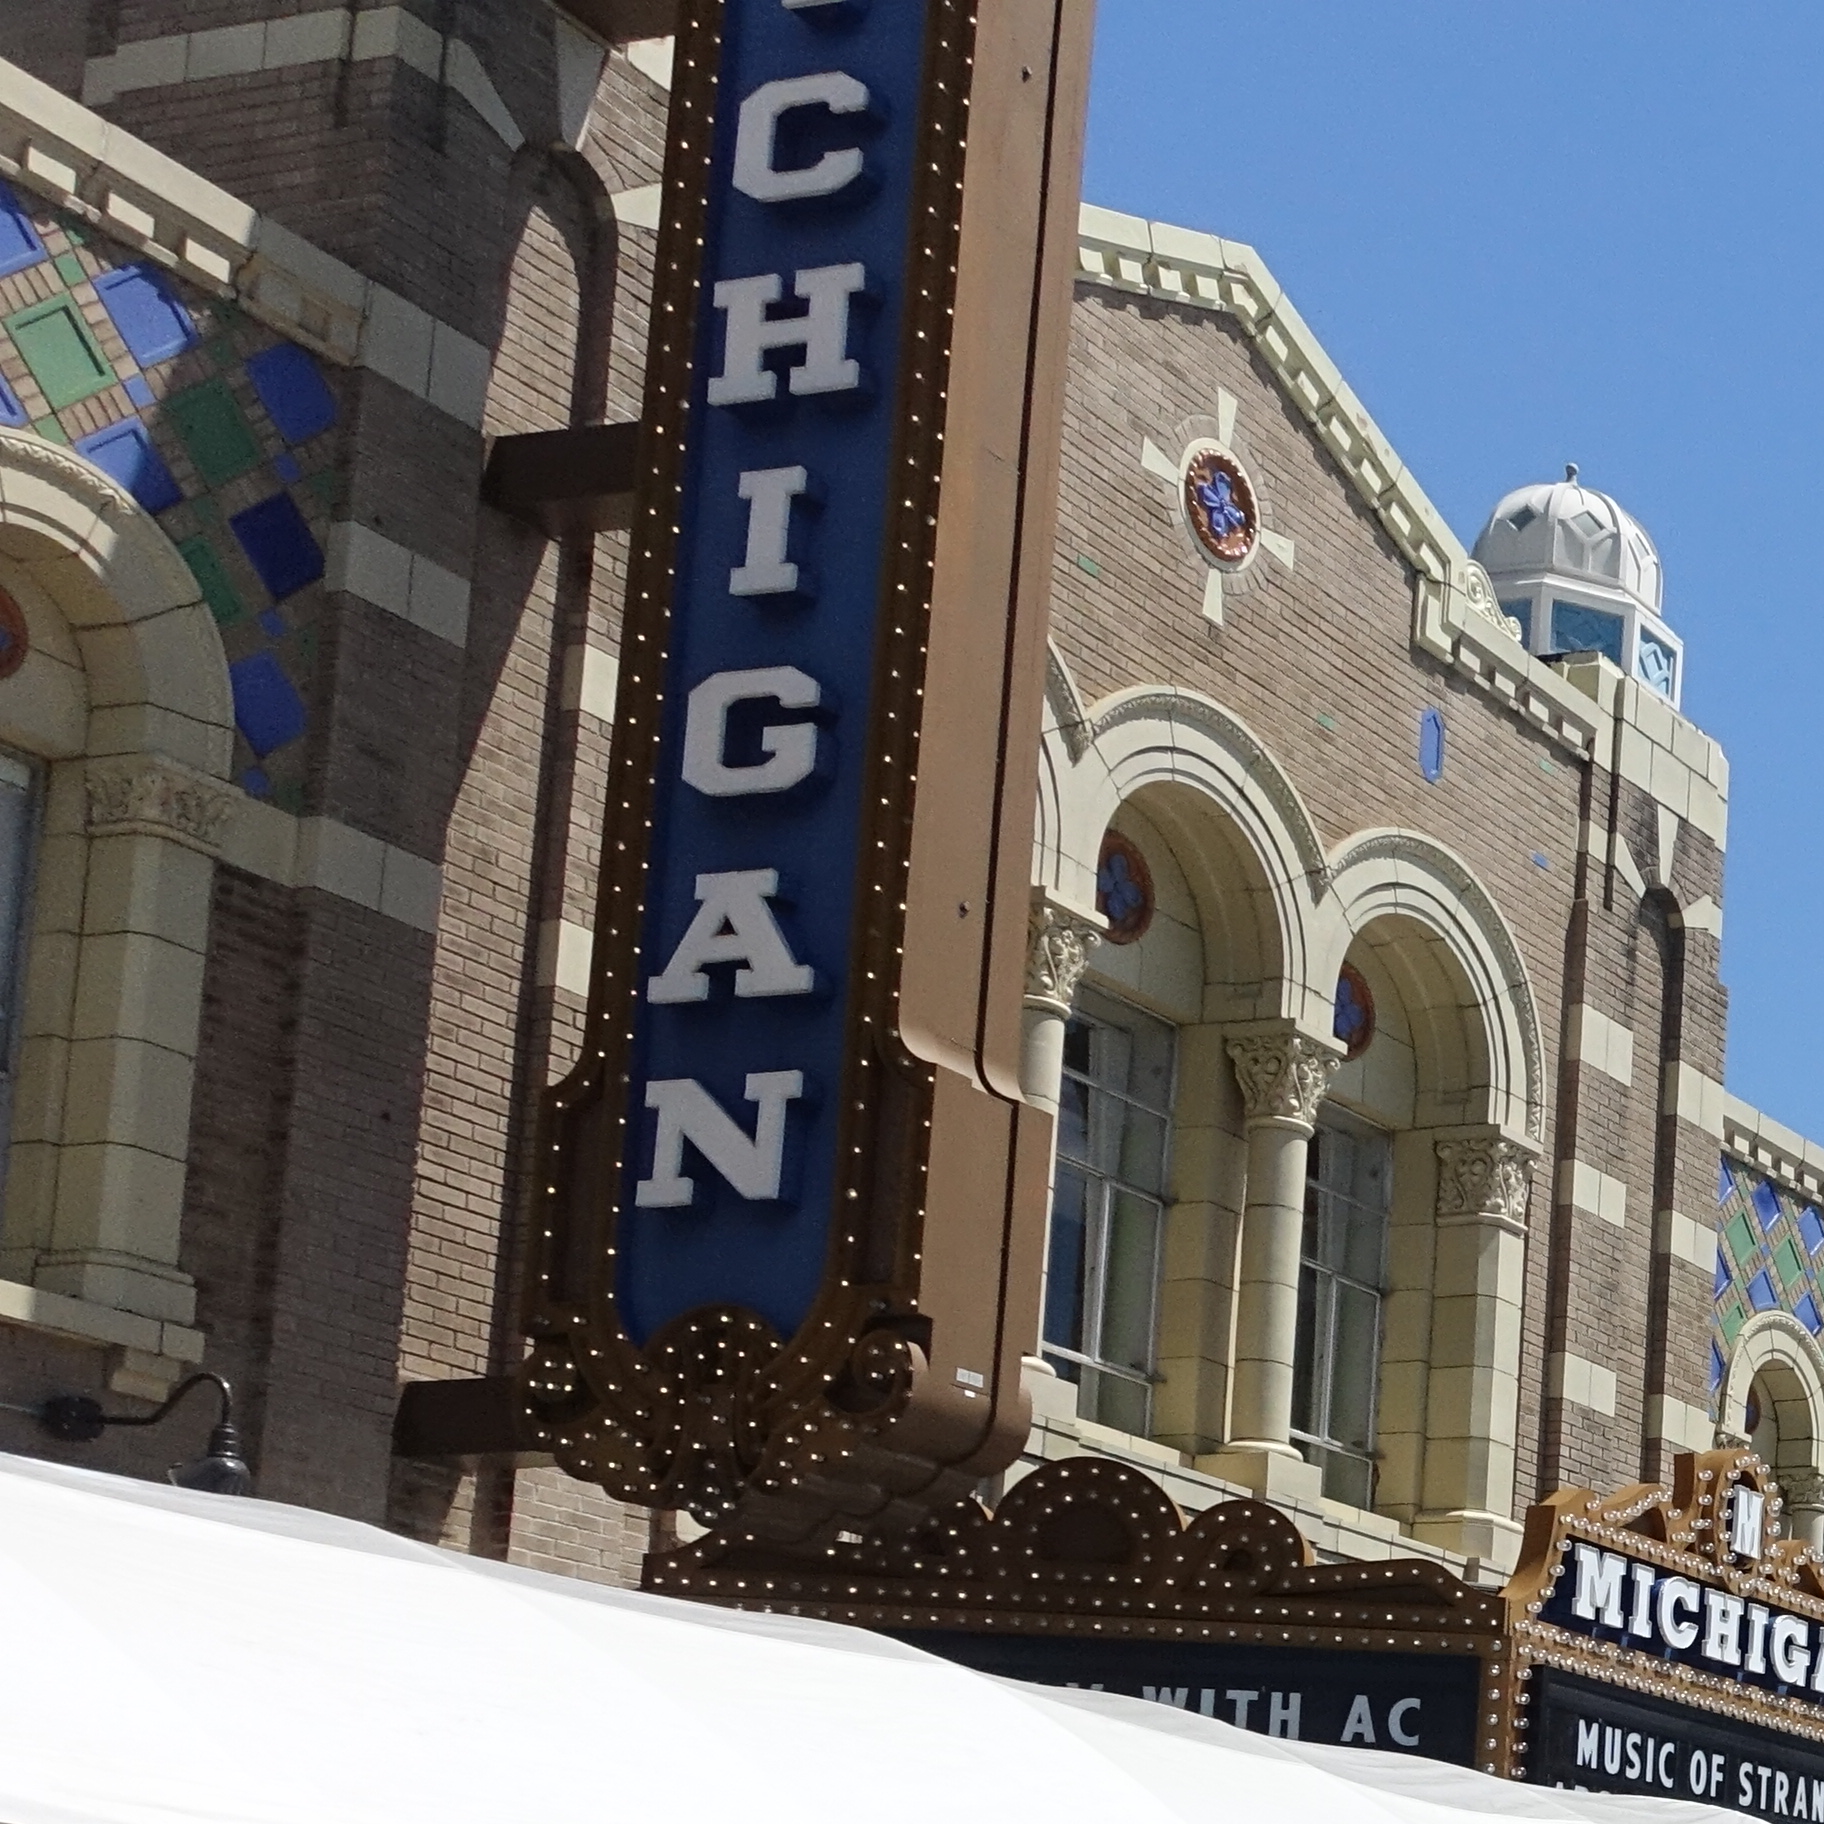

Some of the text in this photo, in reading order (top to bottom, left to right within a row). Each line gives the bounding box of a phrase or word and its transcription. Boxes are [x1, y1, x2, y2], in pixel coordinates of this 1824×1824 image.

[634, 0, 874, 1208] CHIGAN
[1730, 1485, 1765, 1560] M
[1340, 1694, 1421, 1747] AC
[1576, 1718, 1675, 1789] MUSIC
[1689, 1749, 1725, 1798] OF
